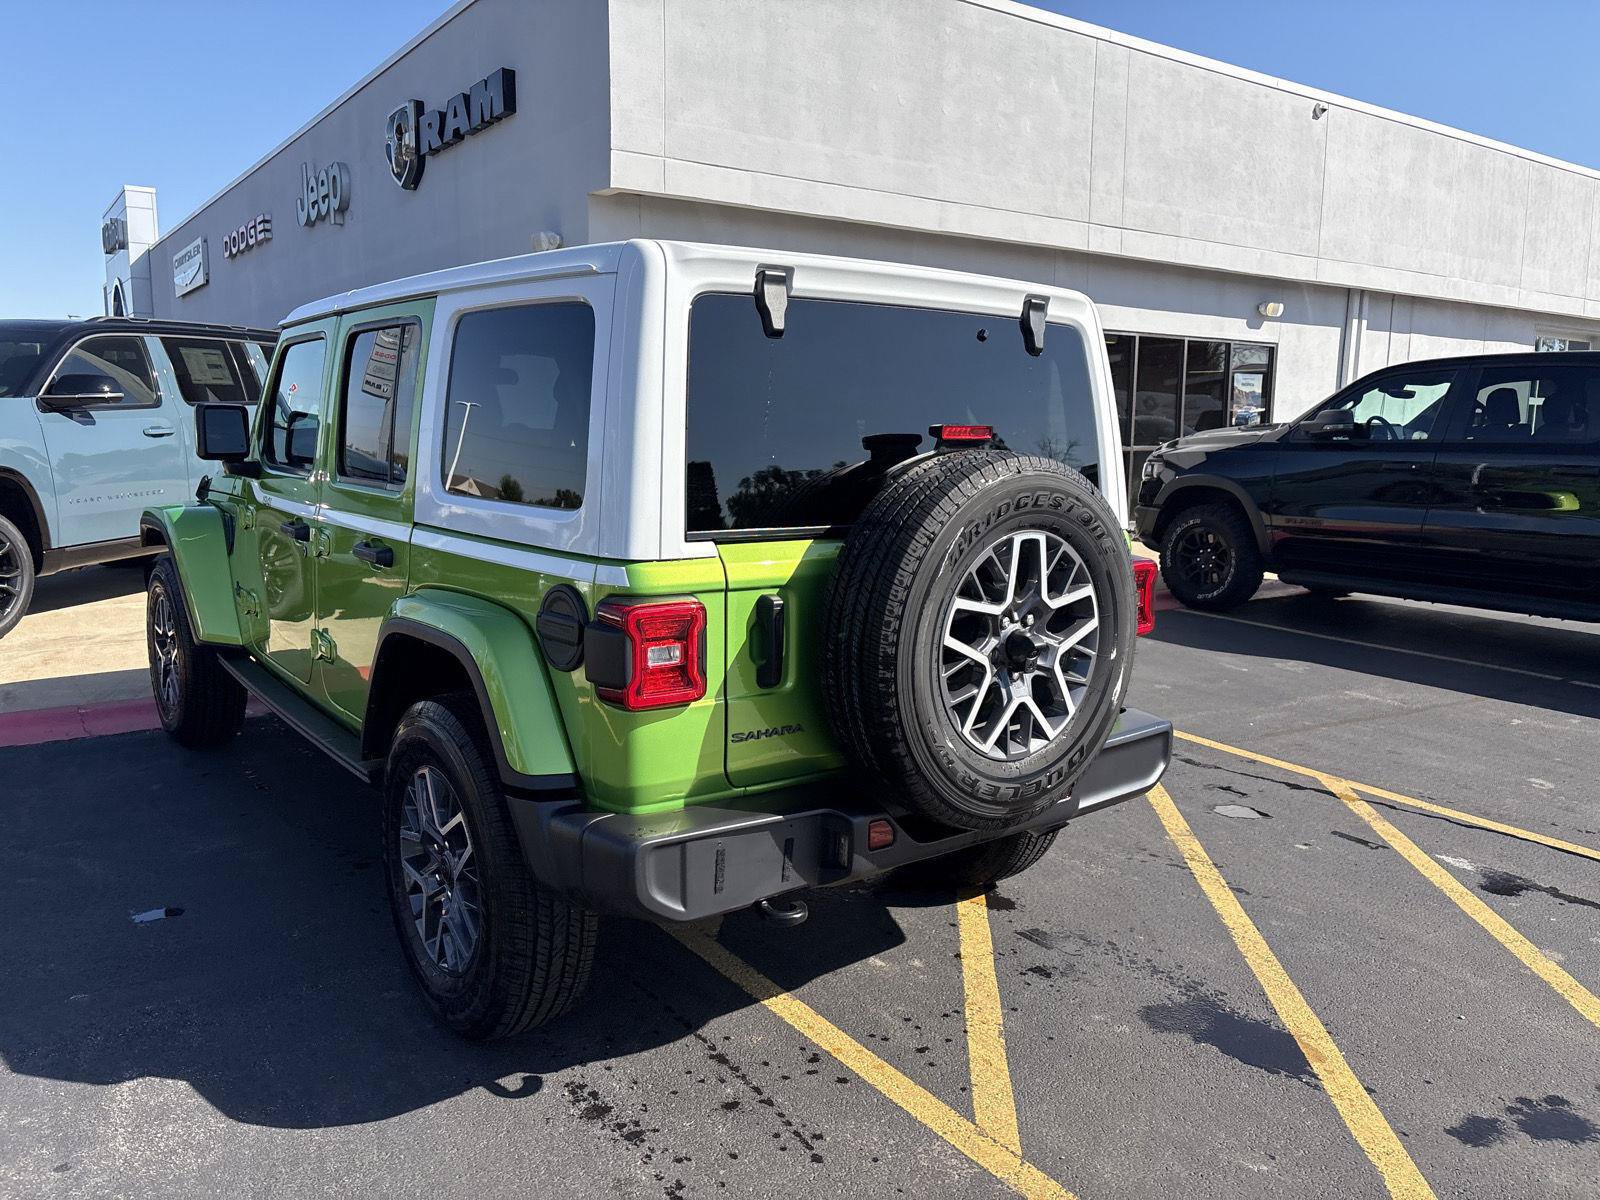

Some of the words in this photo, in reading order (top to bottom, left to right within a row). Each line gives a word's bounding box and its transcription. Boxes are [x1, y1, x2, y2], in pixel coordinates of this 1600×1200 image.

[419, 67, 516, 156] RAM
[296, 161, 347, 227] Jeep
[173, 245, 201, 269] CHRYSLER
[223, 213, 273, 259] DODGE
[949, 490, 1117, 569] BRIDGESTONE
[730, 722, 805, 744] SAHARA
[956, 744, 1086, 801] DUELER
